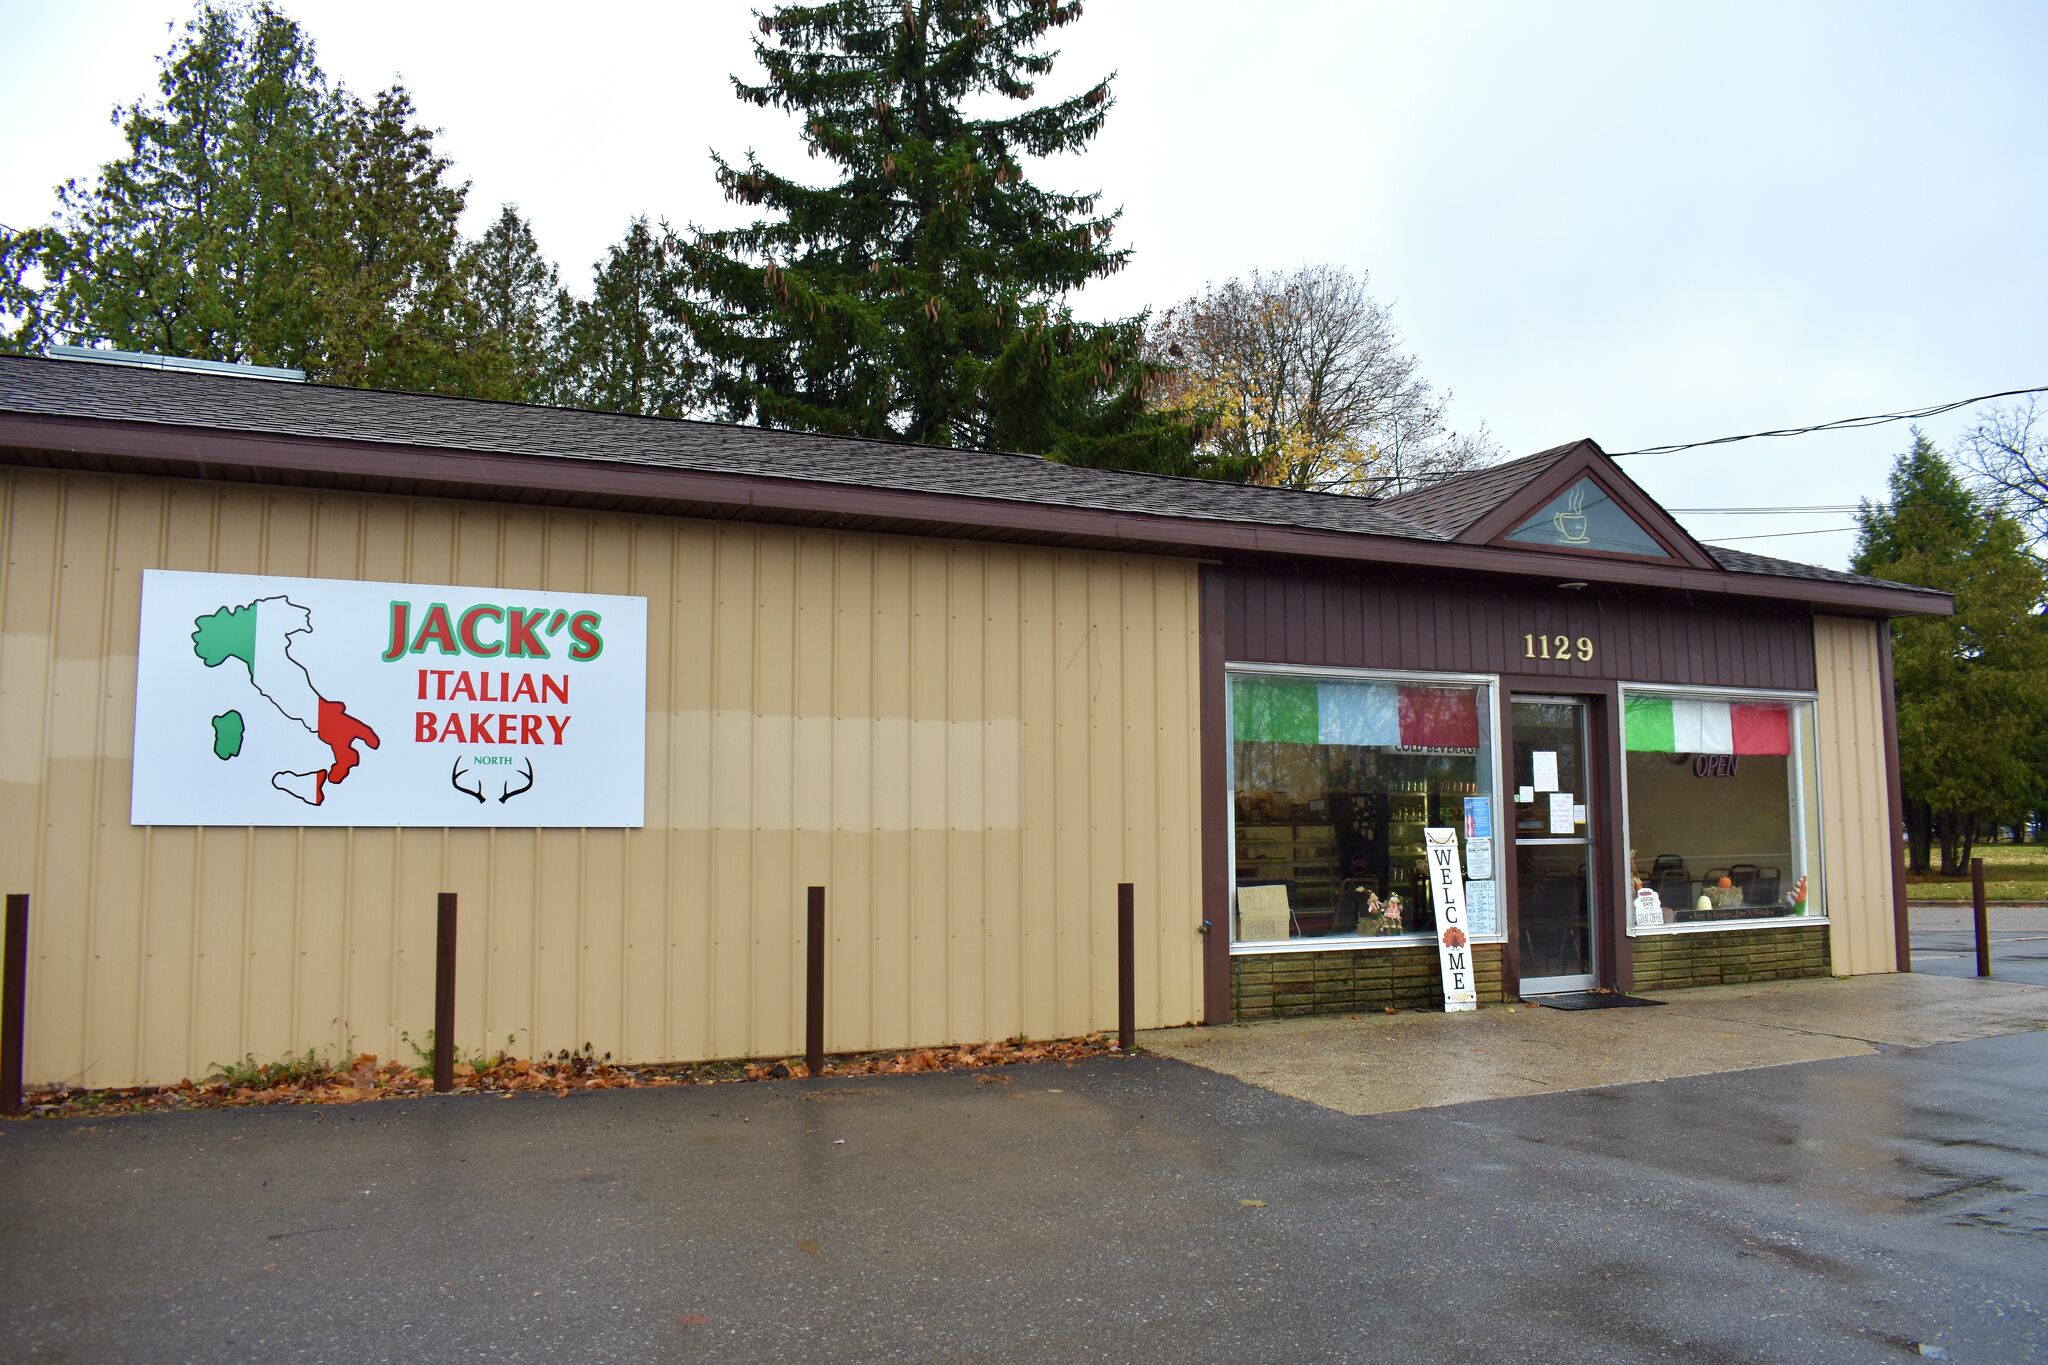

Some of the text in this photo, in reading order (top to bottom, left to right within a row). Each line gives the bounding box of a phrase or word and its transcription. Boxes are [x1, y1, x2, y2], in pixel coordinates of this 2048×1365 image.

[382, 600, 604, 663] JACK'S
[1523, 633, 1595, 662] 1129
[417, 669, 570, 705] ITALIAN
[414, 711, 572, 746] BAKERY
[473, 756, 513, 766] NORTH
[1695, 755, 1739, 777] OPEN
